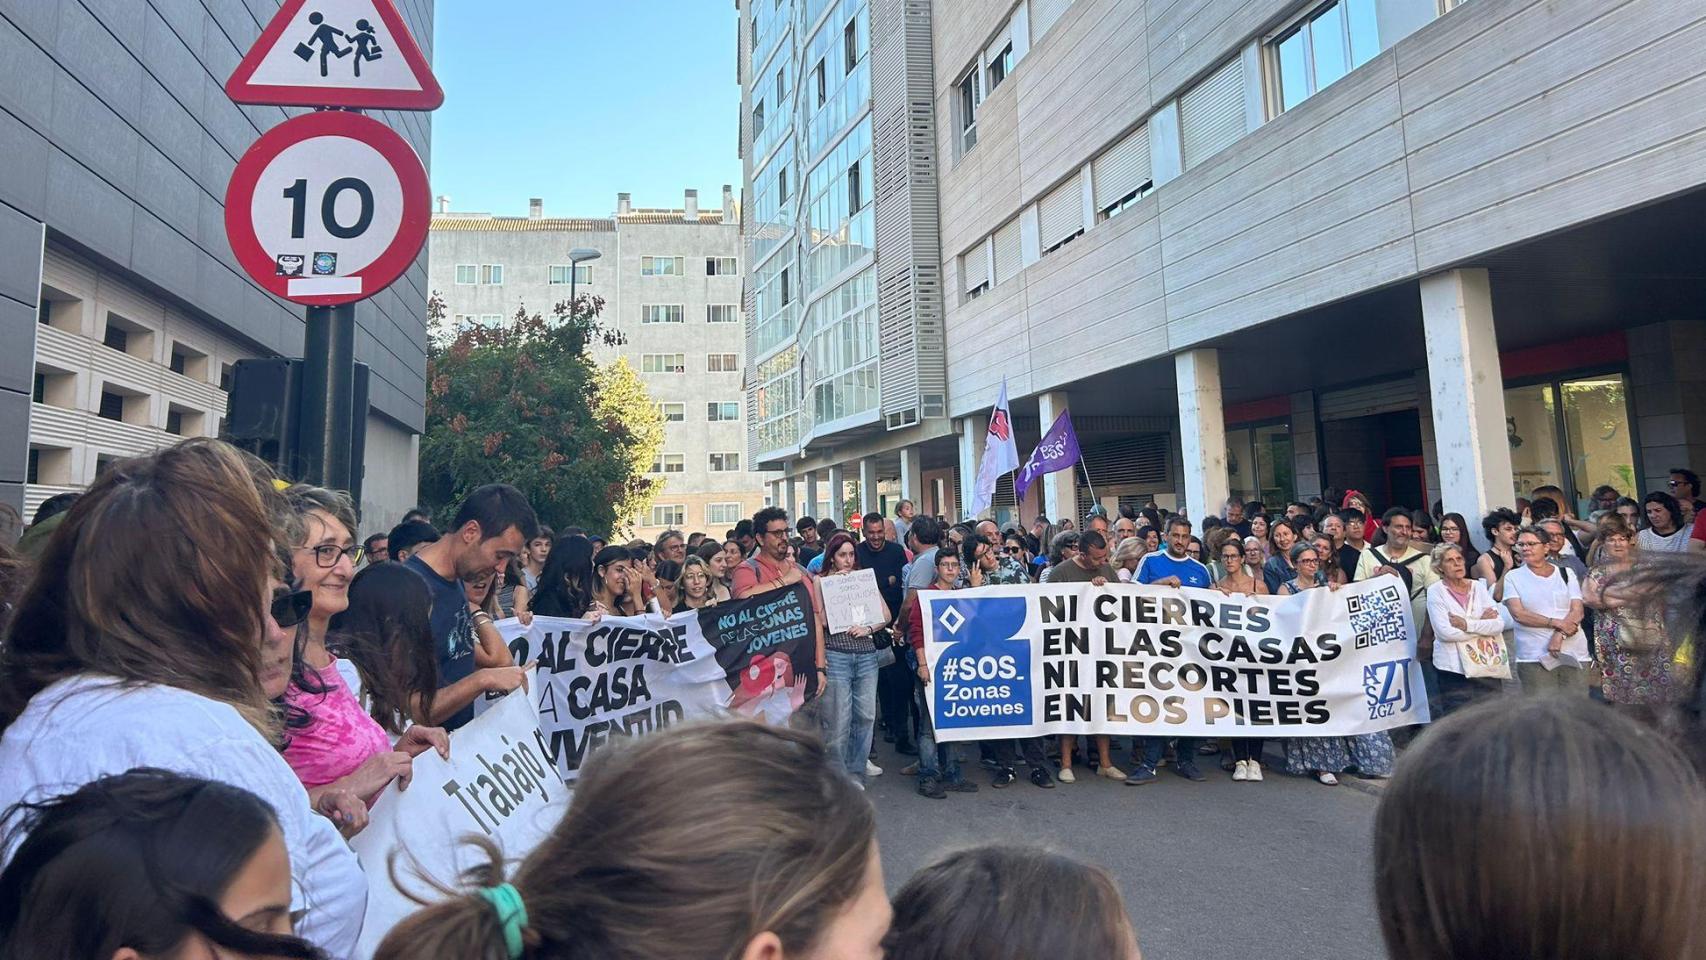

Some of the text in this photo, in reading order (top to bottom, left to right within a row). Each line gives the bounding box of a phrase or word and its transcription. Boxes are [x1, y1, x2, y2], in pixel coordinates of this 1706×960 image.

[283, 177, 375, 239] 10
[718, 614, 737, 630] NO
[738, 608, 754, 624] AL
[762, 606, 804, 630] ONAS
[1039, 594, 1271, 633] NI CIERRES
[536, 631, 576, 674] AL
[584, 624, 695, 668] CIERRE
[746, 622, 808, 654] JOVENES
[1042, 627, 1342, 664] EN LAS CASAS
[568, 664, 652, 720] CASA
[943, 684, 1011, 701] Zonas
[1043, 660, 1320, 697] NI RECORTES
[943, 702, 1024, 718] Jovenes
[1044, 693, 1330, 726] EN LOS PIEES
[1368, 702, 1395, 720] ZGZ
[442, 735, 549, 836] Trabajo
